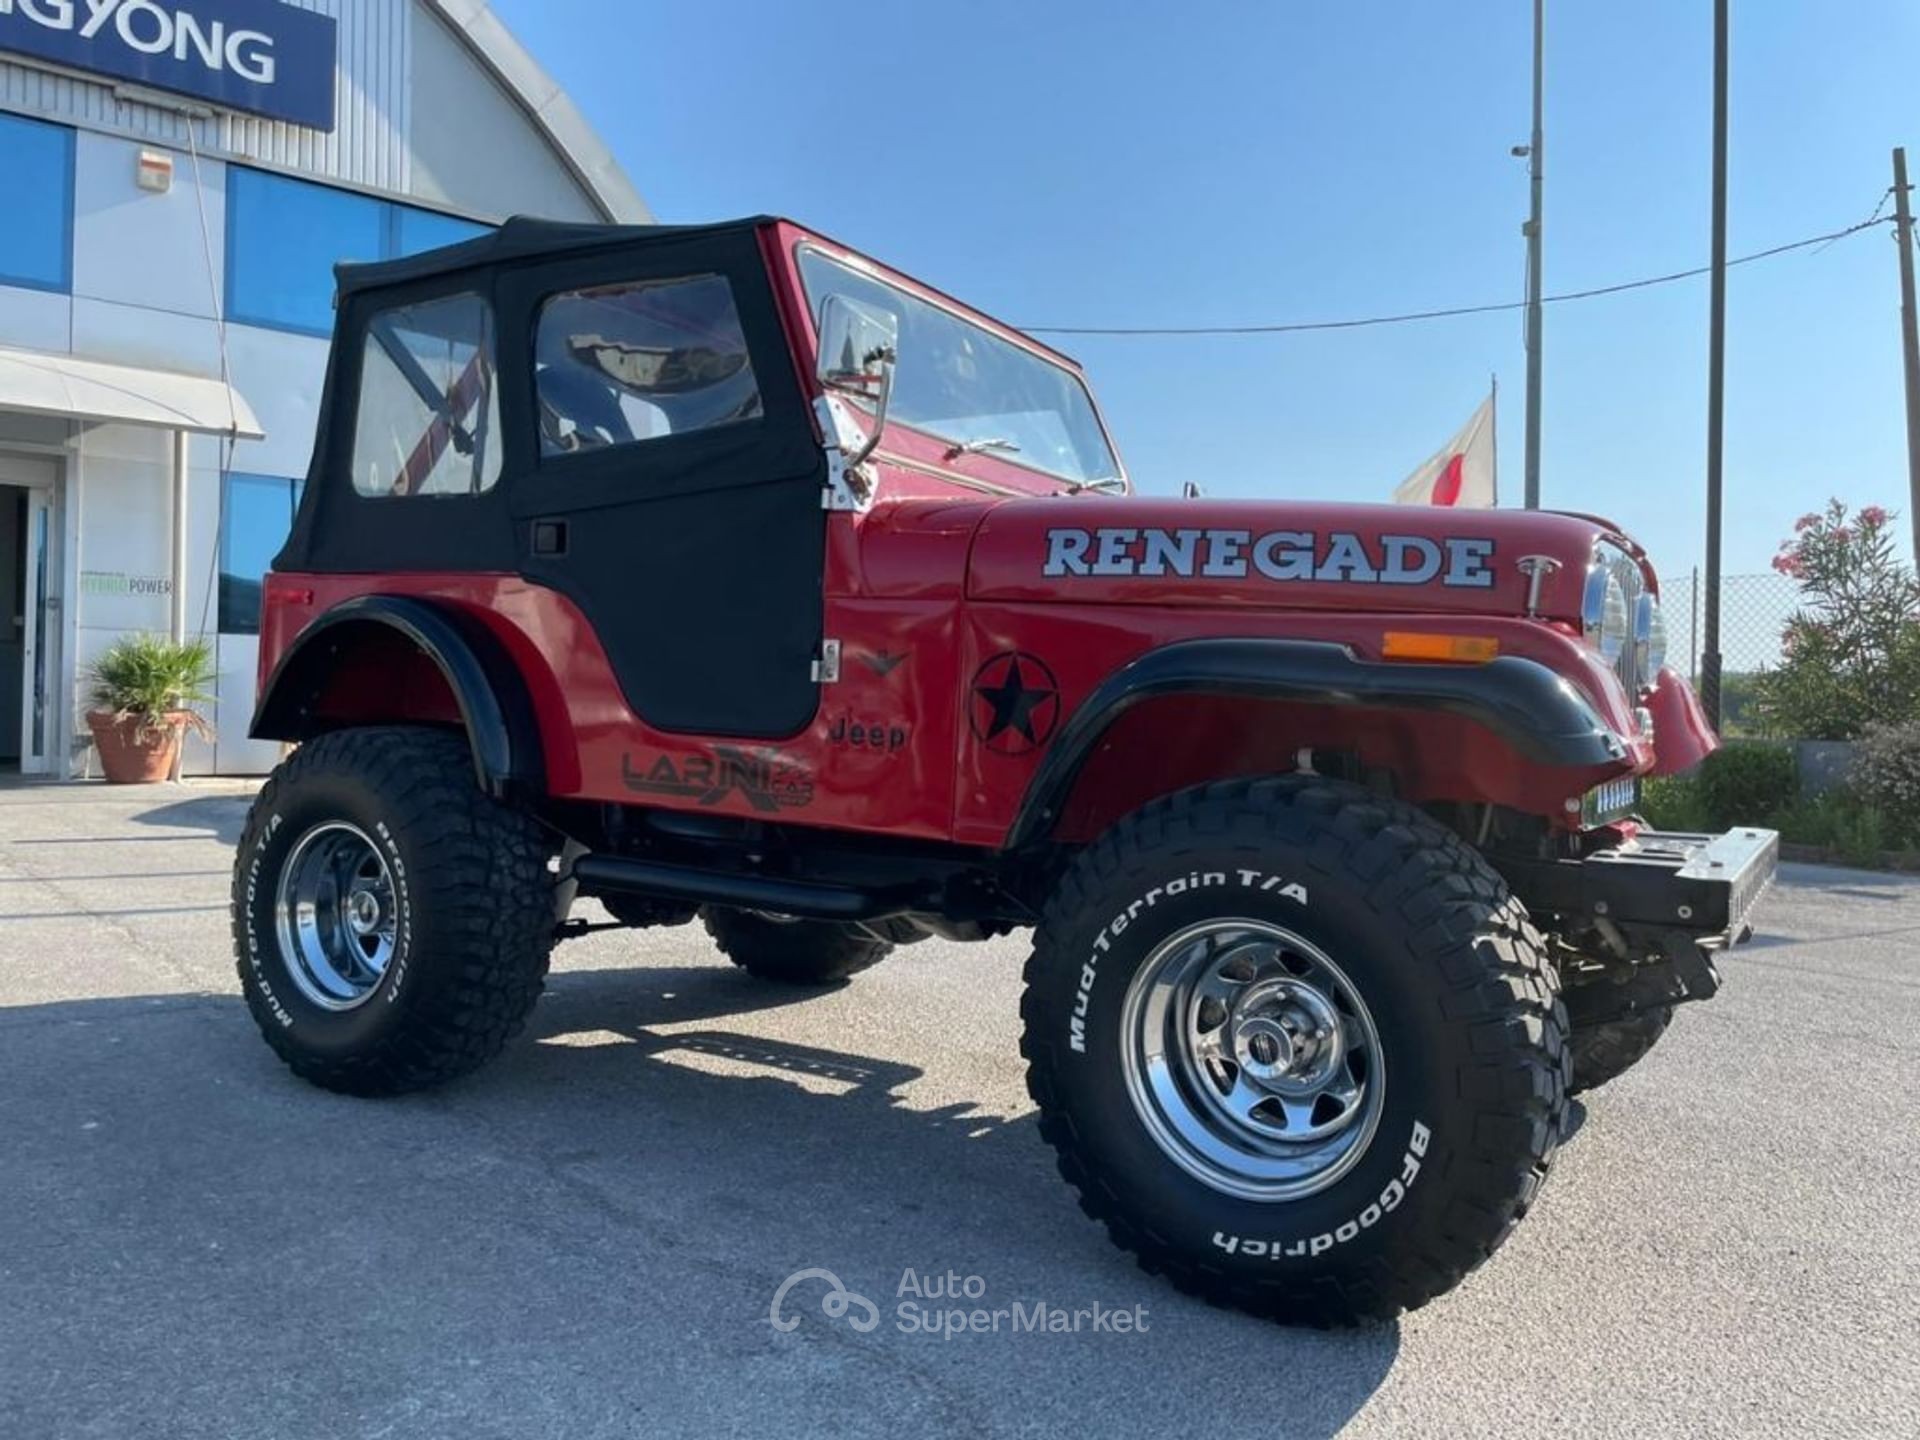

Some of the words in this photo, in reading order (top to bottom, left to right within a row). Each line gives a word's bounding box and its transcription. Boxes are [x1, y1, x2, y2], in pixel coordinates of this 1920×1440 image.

[0, 0, 275, 84] GYONG
[129, 579, 172, 593] POWER
[1042, 527, 1496, 588] RENEGADE
[829, 717, 905, 753] Jeep
[257, 813, 283, 851] T/A
[246, 859, 294, 1028] Mud-Terrain
[1069, 870, 1227, 1054] Mud-Terrain
[1236, 869, 1309, 906] T/A
[1211, 1119, 1432, 1260] BFGoodrich
